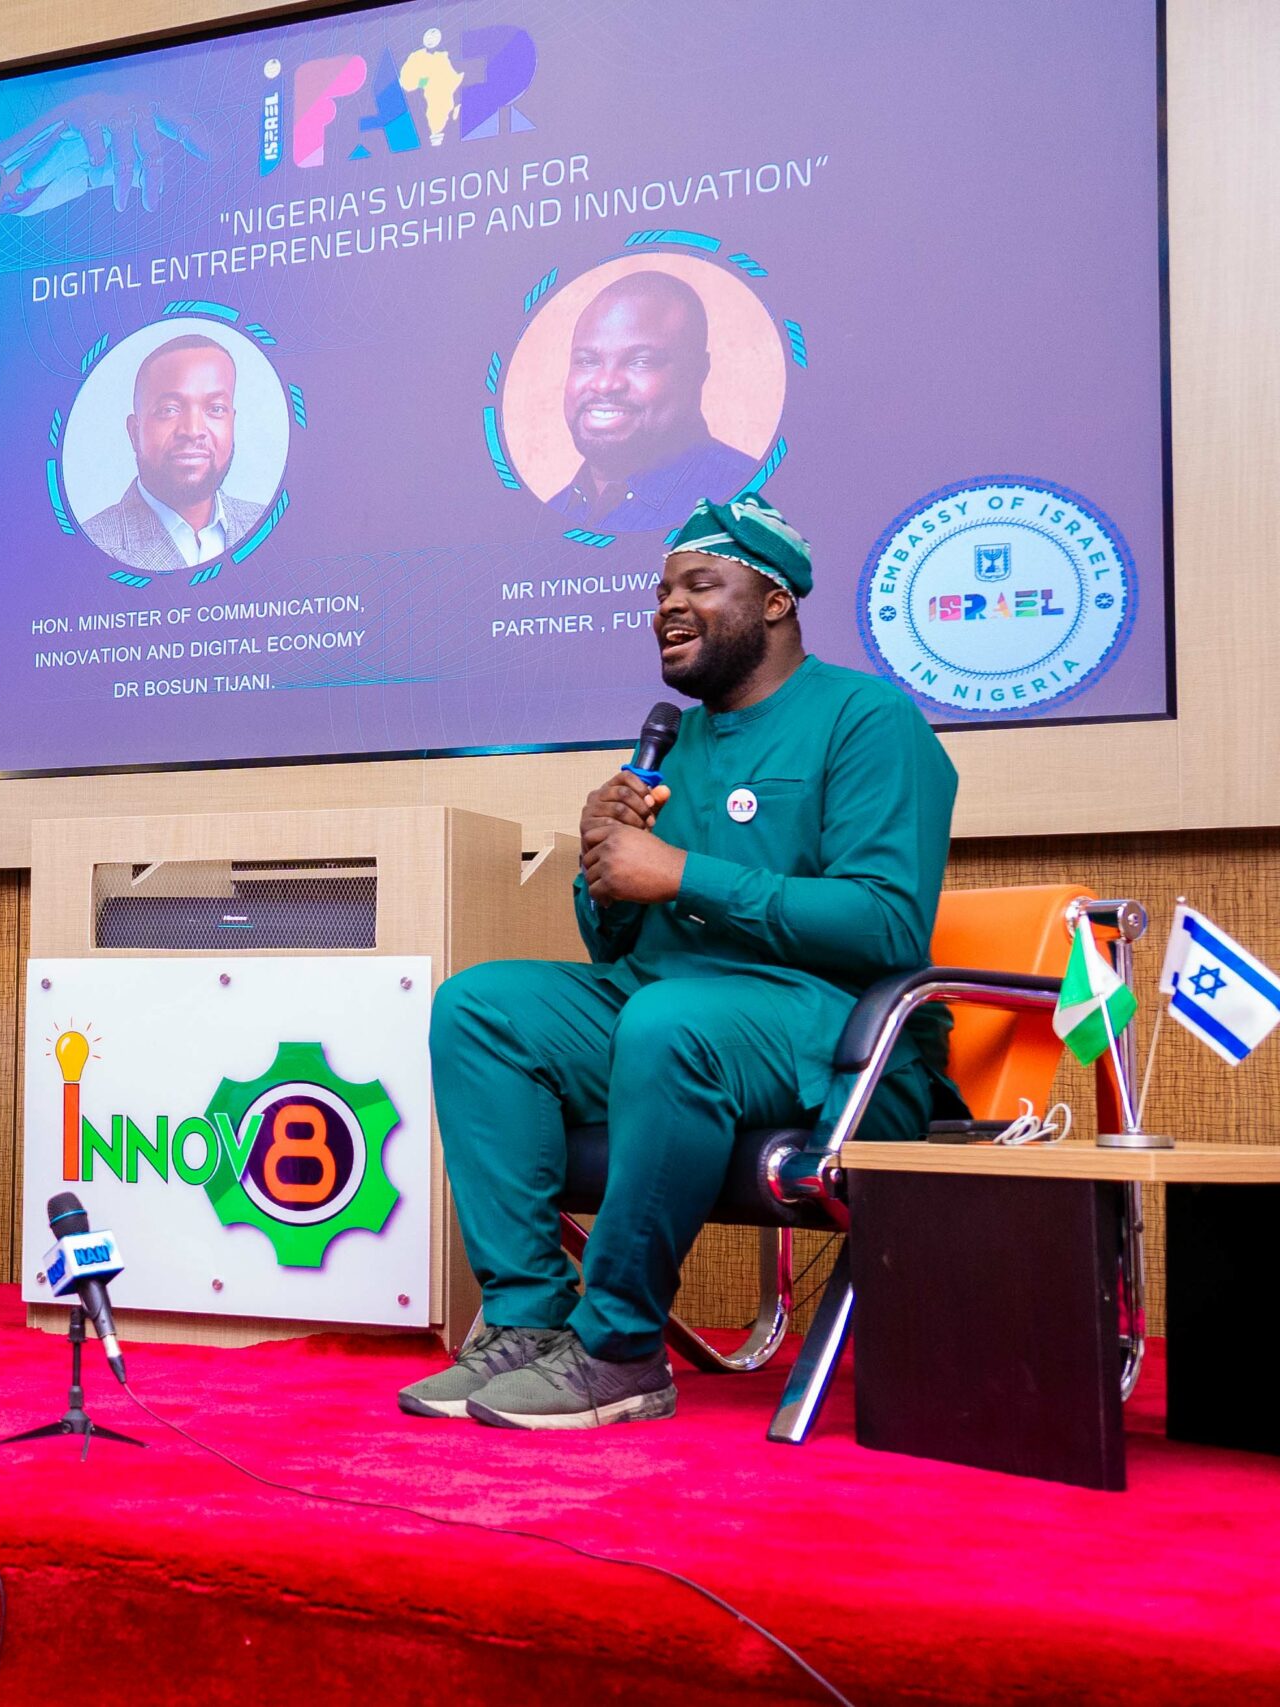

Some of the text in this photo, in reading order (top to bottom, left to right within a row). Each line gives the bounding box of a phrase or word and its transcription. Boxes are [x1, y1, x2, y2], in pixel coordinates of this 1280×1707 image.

[263, 91, 280, 161] ISRAEL
[396, 168, 510, 210] VISION
[522, 155, 590, 192] FOR
[32, 264, 142, 303] DIGITAL
[150, 211, 477, 286] ENTREPRENEURSHIP
[485, 199, 562, 235] AND
[880, 496, 1110, 594] EMBASSY OF ISRAEL
[502, 582, 534, 600] MR
[928, 589, 1064, 622] ISRAEL
[32, 594, 366, 635] HON. MINISTER OF COMMUNICATION,
[492, 614, 594, 637] PARTNER
[35, 630, 366, 668] INNOVATION AND DIGITAL ECONOMY
[114, 674, 276, 698] DR BOSUN TIJANI.
[911, 659, 1080, 701] IN NIGERIA
[74, 1245, 111, 1267] NAN
